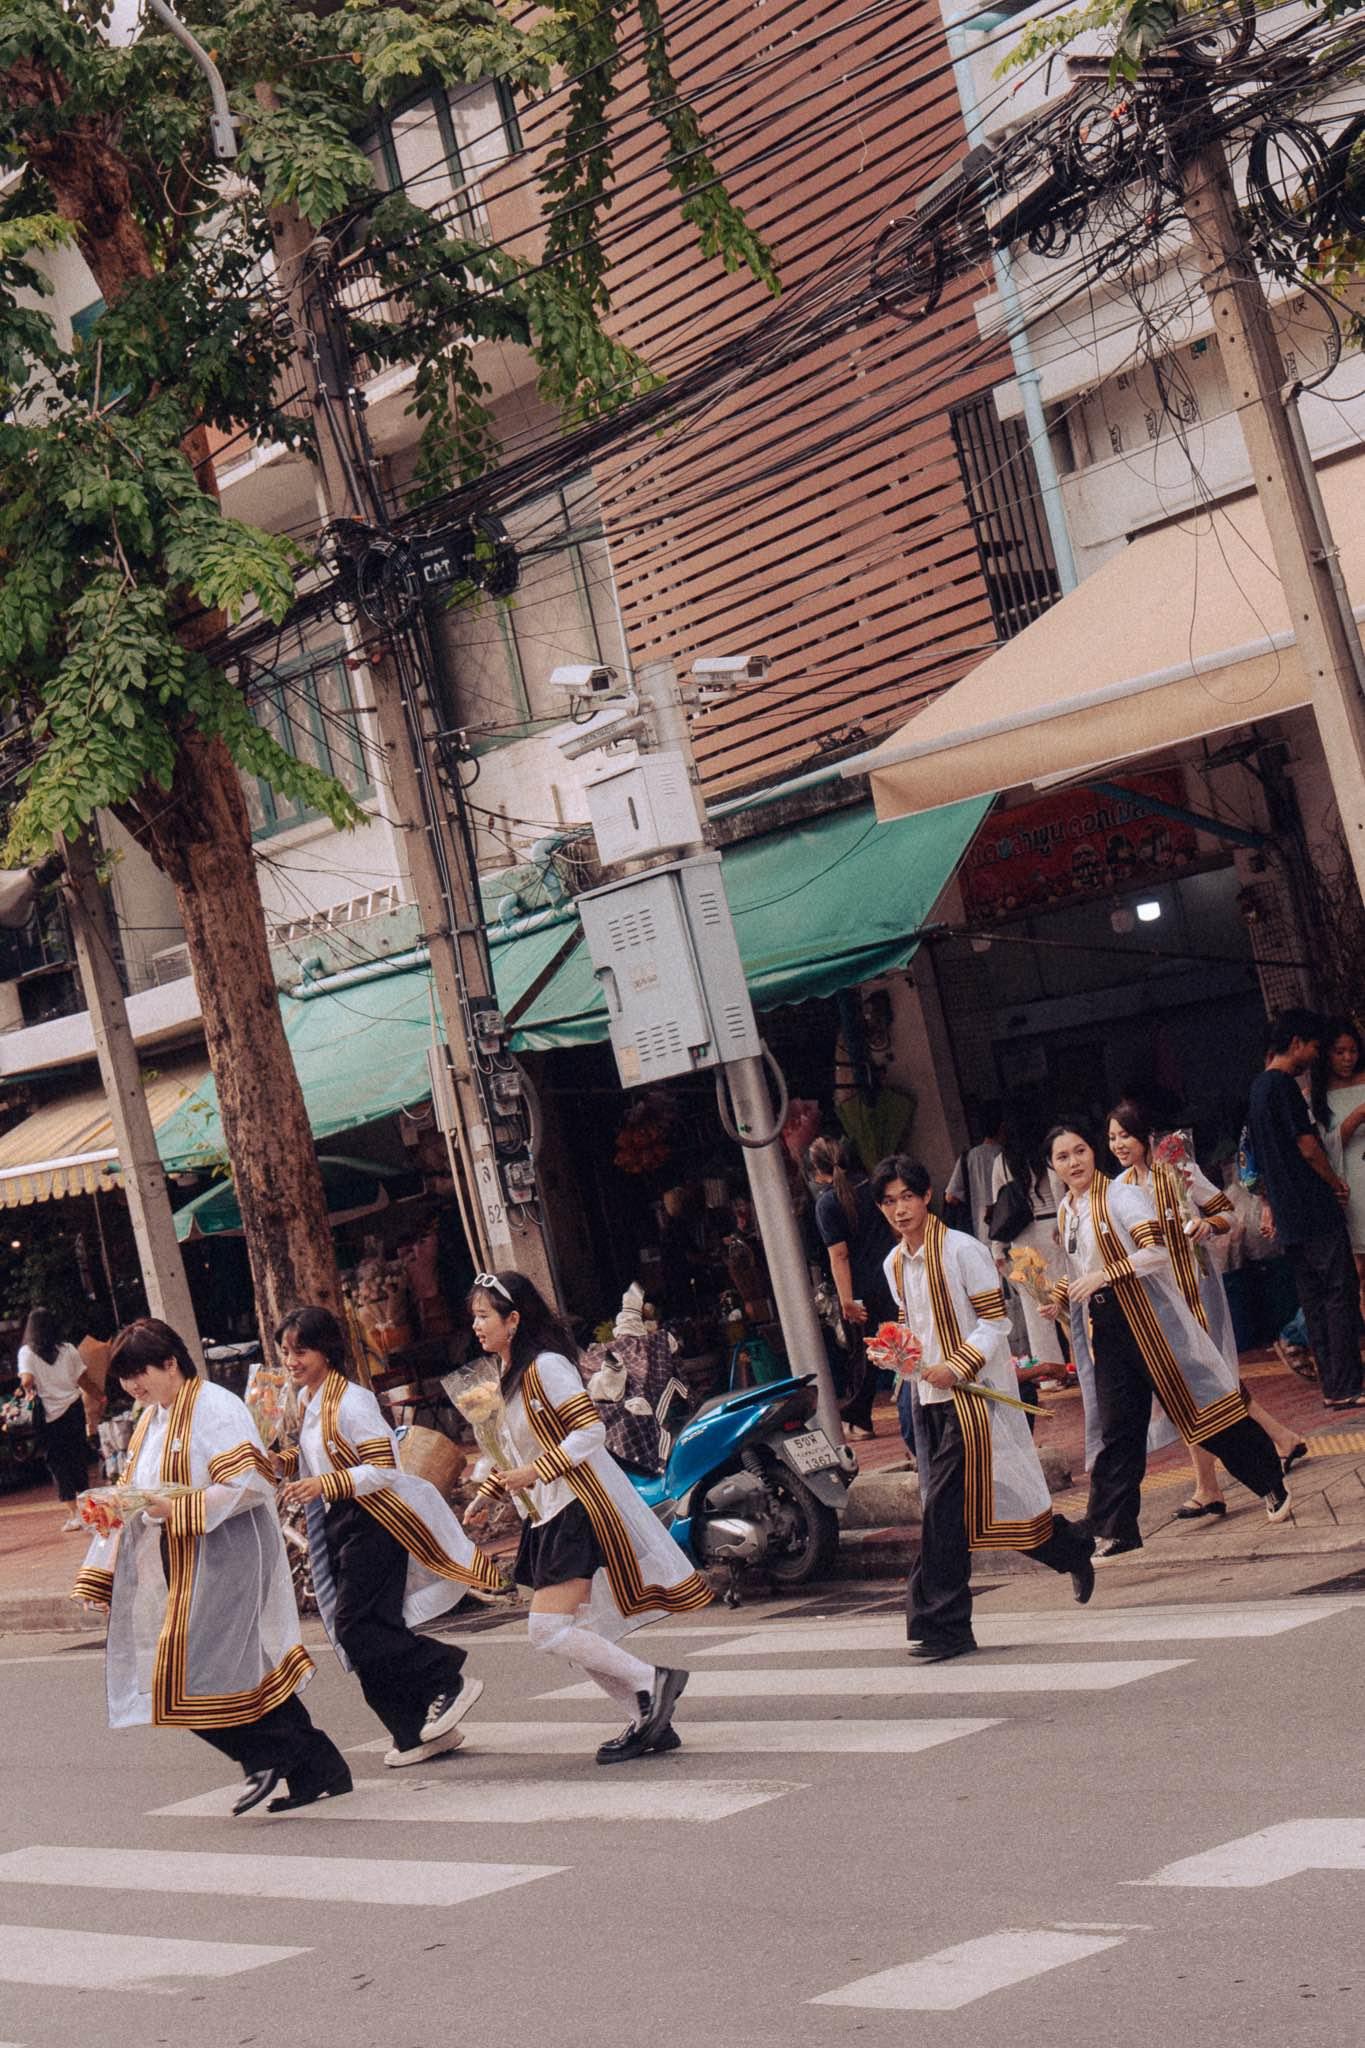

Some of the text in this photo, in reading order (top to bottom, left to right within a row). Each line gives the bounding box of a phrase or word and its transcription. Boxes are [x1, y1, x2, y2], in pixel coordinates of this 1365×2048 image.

[423, 559, 451, 583] CAT
[488, 1204, 503, 1224] 52
[805, 1454, 832, 1469] 1367
